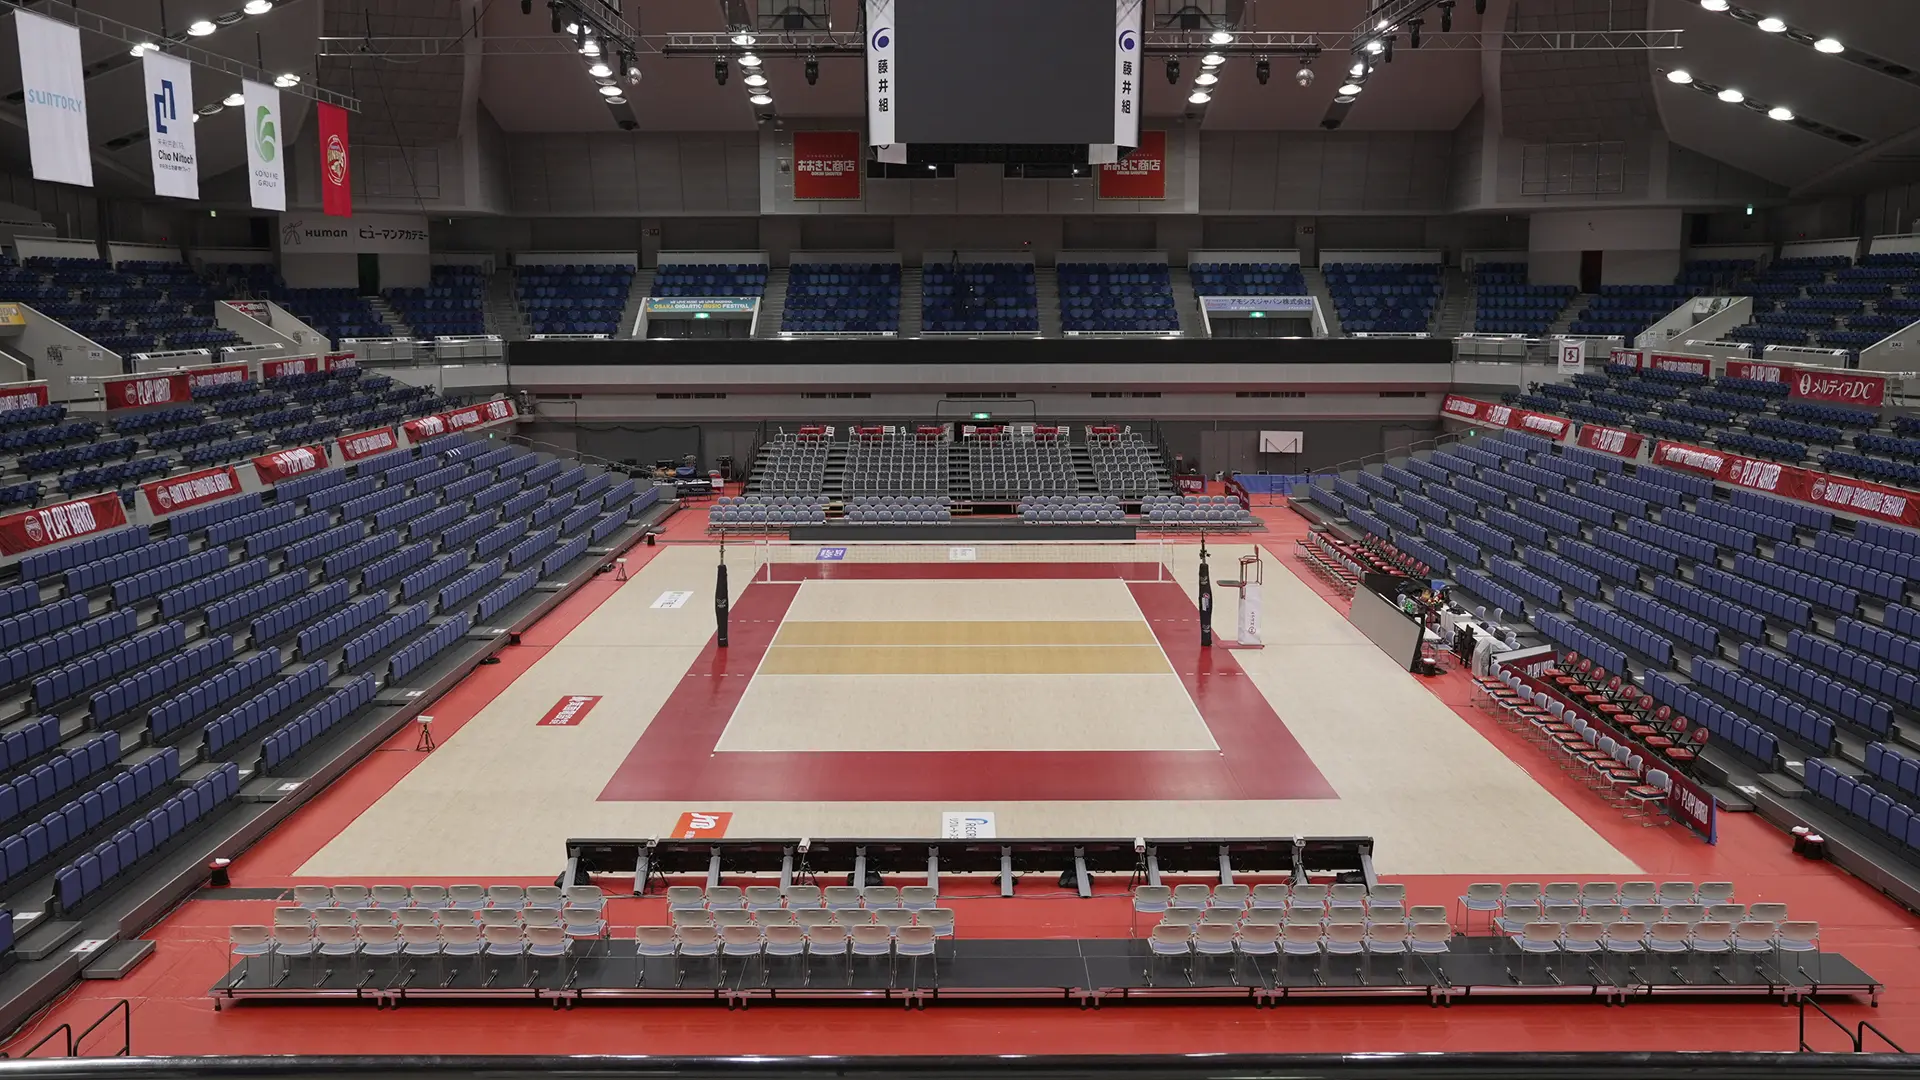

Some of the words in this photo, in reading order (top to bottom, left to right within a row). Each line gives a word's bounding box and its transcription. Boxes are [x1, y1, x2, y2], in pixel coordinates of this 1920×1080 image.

[877, 59, 889, 113] 藤井組
[1121, 60, 1132, 114] 藤井組
[28, 88, 82, 113] SUNTORY
[798, 160, 855, 171] おおきに商店
[359, 225, 429, 240] ヒューマンアカデミー
[136, 379, 154, 405] PLAY
[152, 377, 171, 403] HARD
[1812, 379, 1875, 399] メルディアDC
[1597, 429, 1615, 451] PLAY
[1739, 459, 1763, 487] PLAY
[1756, 463, 1782, 491] HARD
[1824, 481, 1854, 505] SUNTORY
[1850, 487, 1884, 512] SUNBIRDS
[39, 505, 74, 541] PLAY
[66, 501, 97, 535] HARD
[1681, 787, 1696, 815] PLAY
